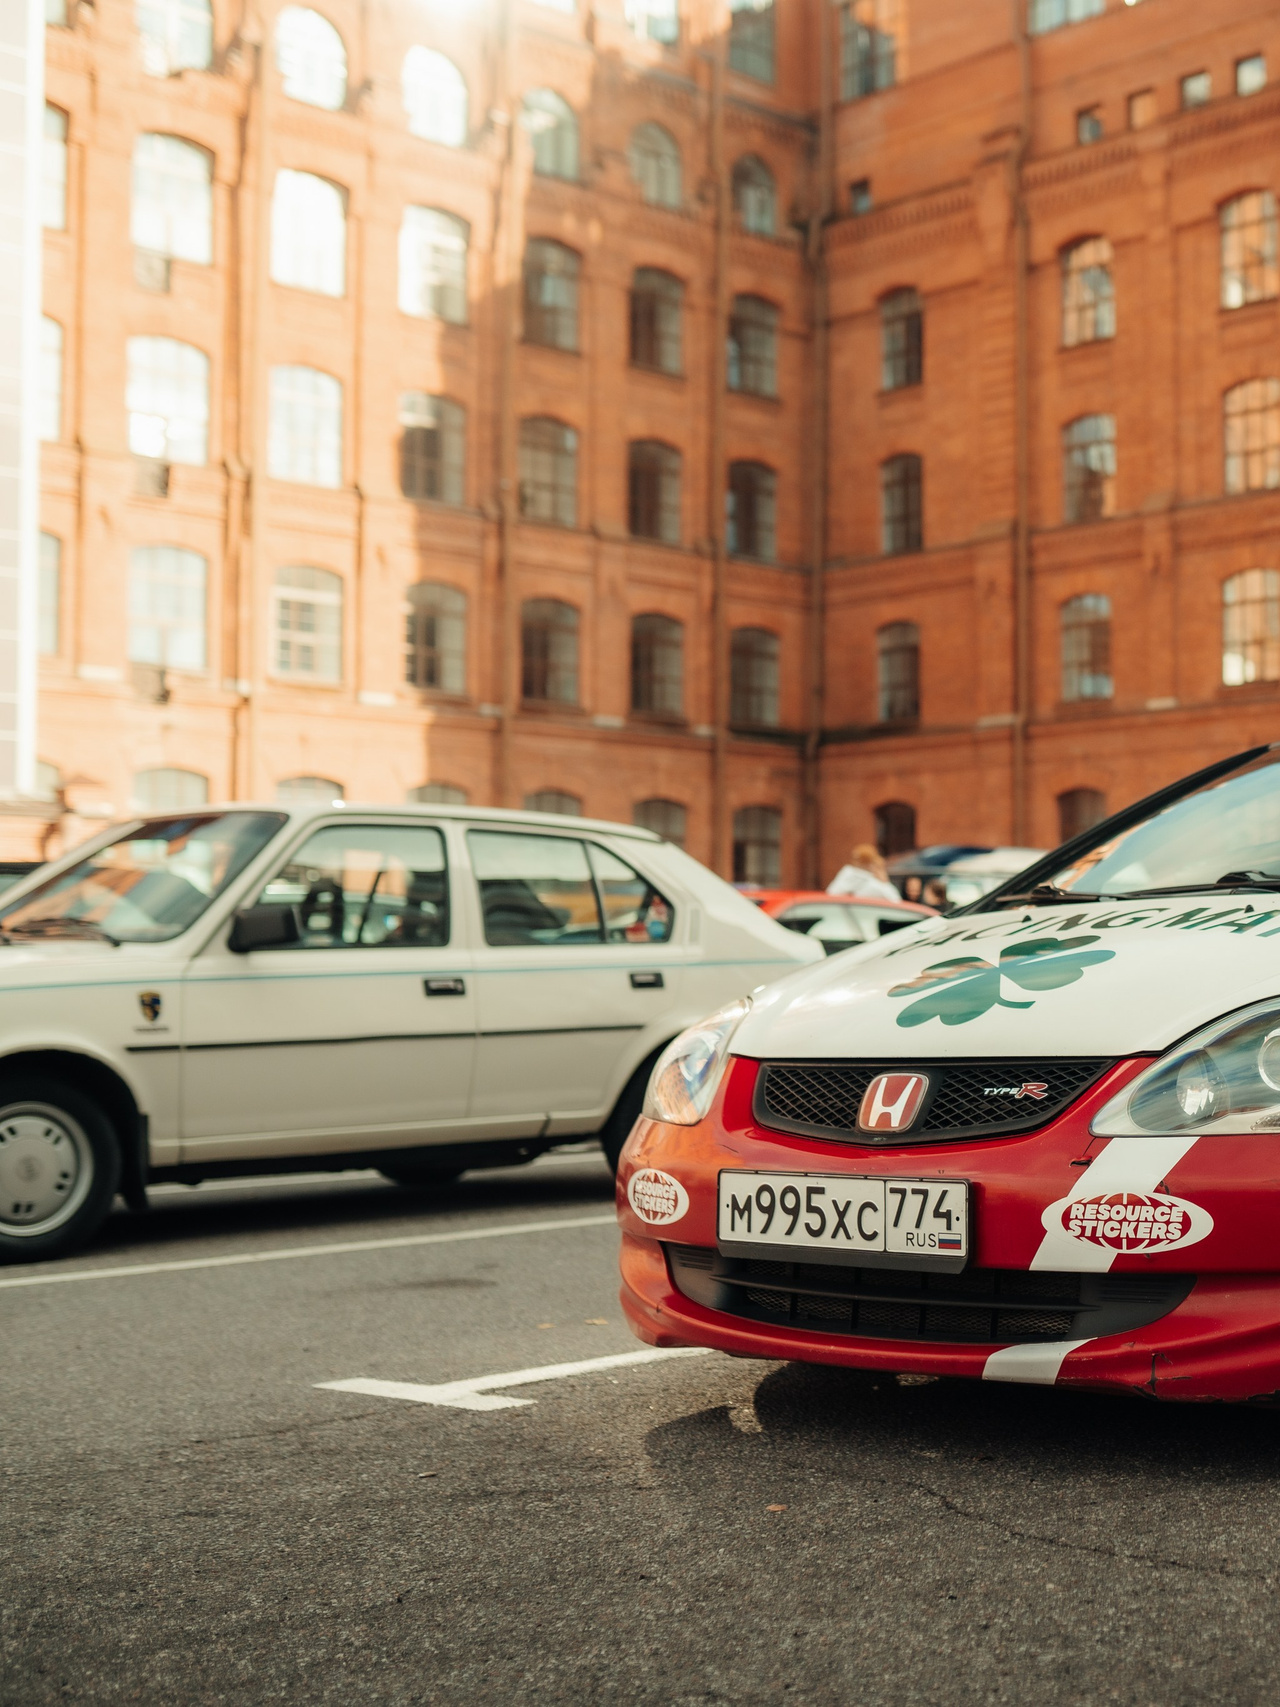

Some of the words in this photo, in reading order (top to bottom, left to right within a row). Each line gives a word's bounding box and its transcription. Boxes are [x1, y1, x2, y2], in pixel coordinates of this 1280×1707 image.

[984, 1087, 1020, 1096] TYPE
[1015, 1083, 1048, 1100] R
[889, 1187, 952, 1231] 774
[1070, 1203, 1185, 1223] RESOURCE
[1067, 1219, 1183, 1240] STICKERS
[905, 1232, 937, 1248] RUS
